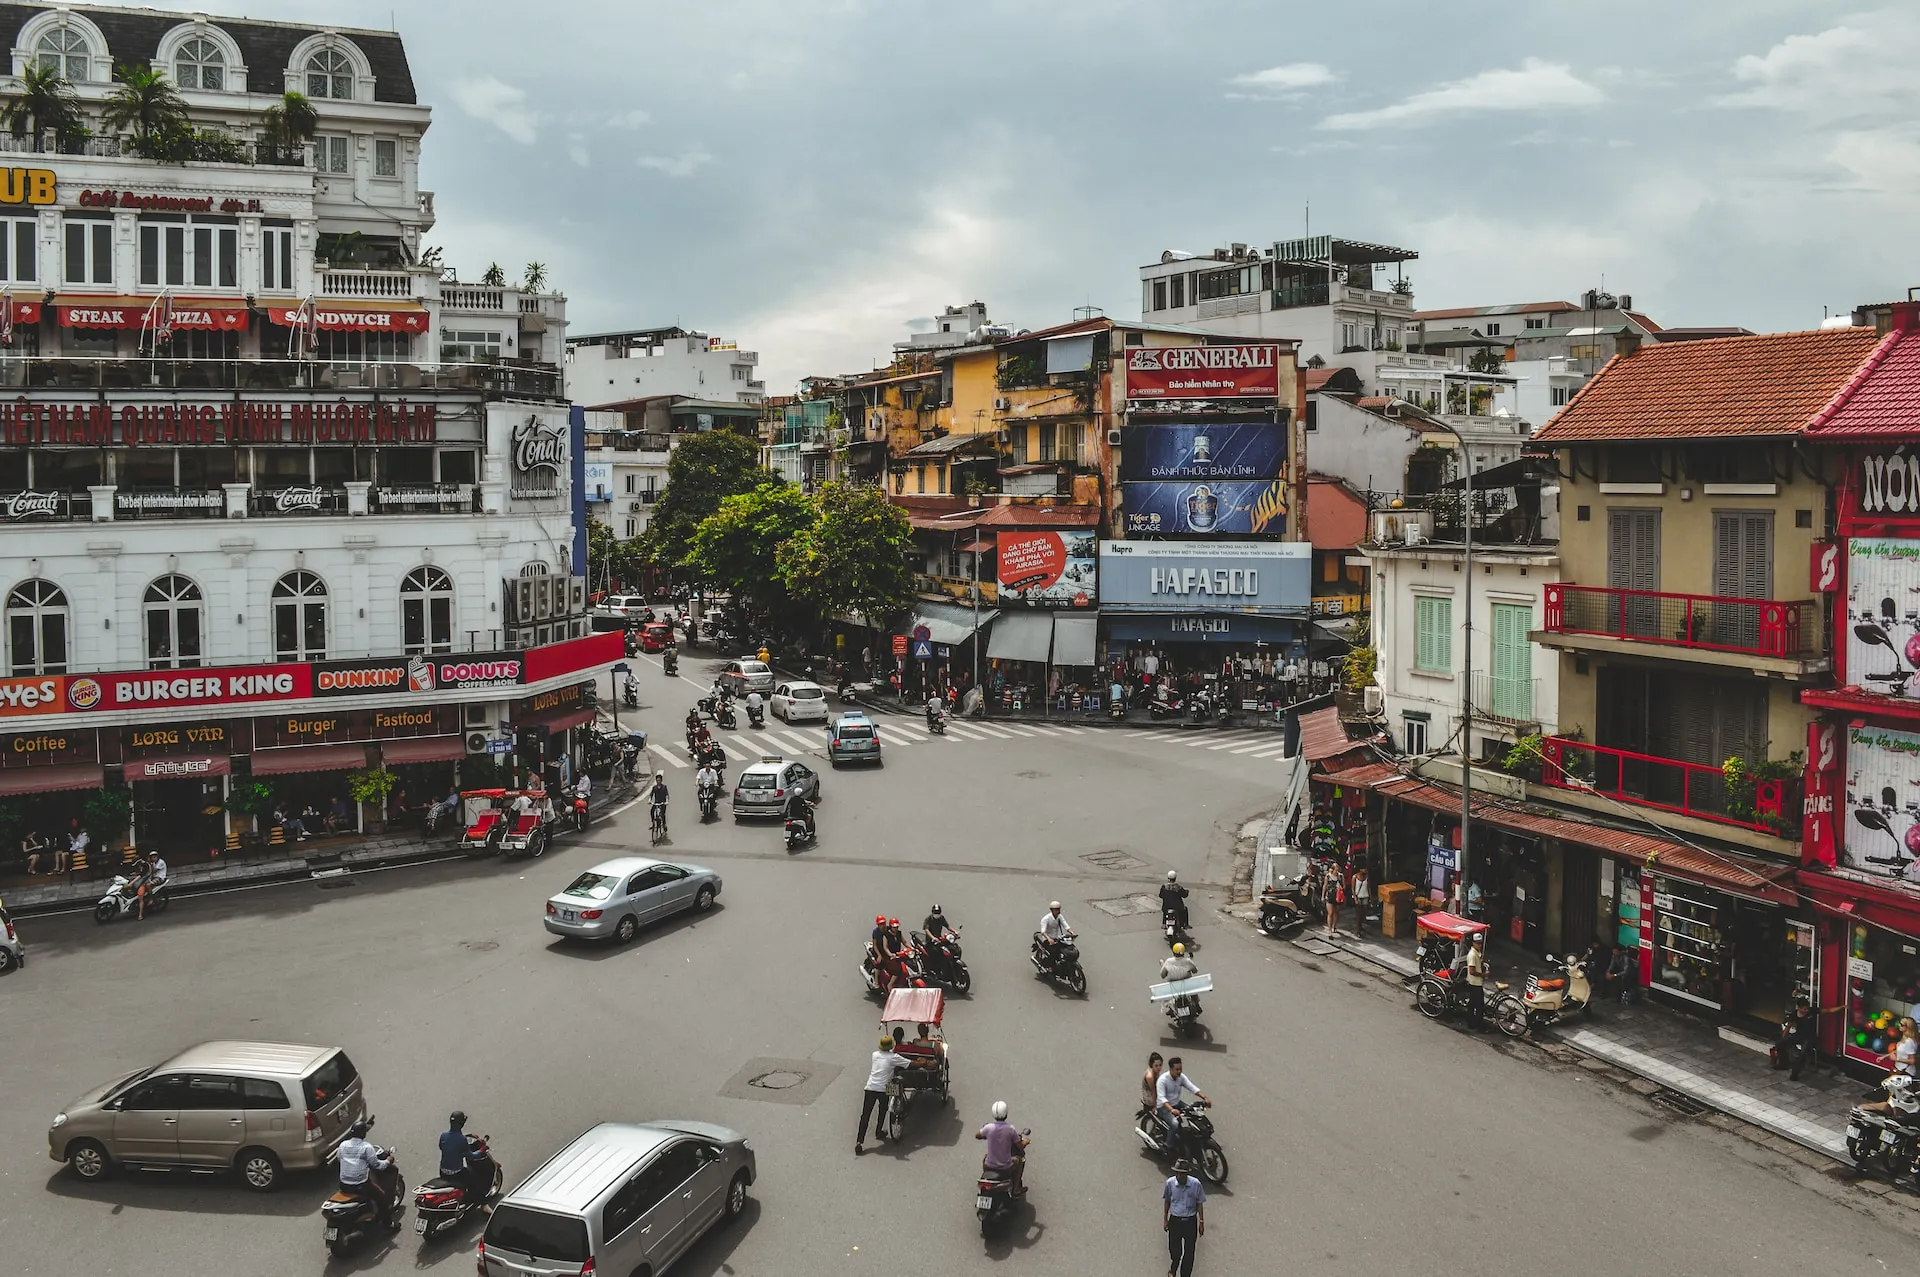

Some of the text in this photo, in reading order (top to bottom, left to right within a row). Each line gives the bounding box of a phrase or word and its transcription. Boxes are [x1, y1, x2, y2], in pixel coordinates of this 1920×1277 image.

[120, 192, 214, 212] Restaurant
[70, 309, 125, 324] STEAK
[169, 310, 213, 325] PIZZA
[285, 310, 392, 327] SANDWICH
[1162, 347, 1274, 370] GENERALI
[120, 405, 216, 447] QUANG
[220, 403, 283, 443] VINH
[118, 495, 129, 508] The
[129, 494, 143, 508] best
[143, 494, 184, 507] entertainment
[184, 494, 200, 507] show
[379, 491, 389, 504] The
[389, 491, 401, 504] best
[401, 490, 438, 503] entertainment
[438, 490, 452, 503] show
[1128, 513, 1149, 524] Tiger
[1112, 544, 1133, 555] Hapro
[1151, 567, 1259, 596] HAFASCO
[1171, 619, 1230, 633] HAFASCO
[319, 667, 405, 690] DUNKIN'
[441, 661, 519, 682] DONUTS
[73, 689, 99, 702] KING
[116, 673, 293, 703] BURGER KING
[287, 718, 337, 736] Burger
[375, 710, 433, 729] Fastfood
[14, 735, 67, 754] Coffee
